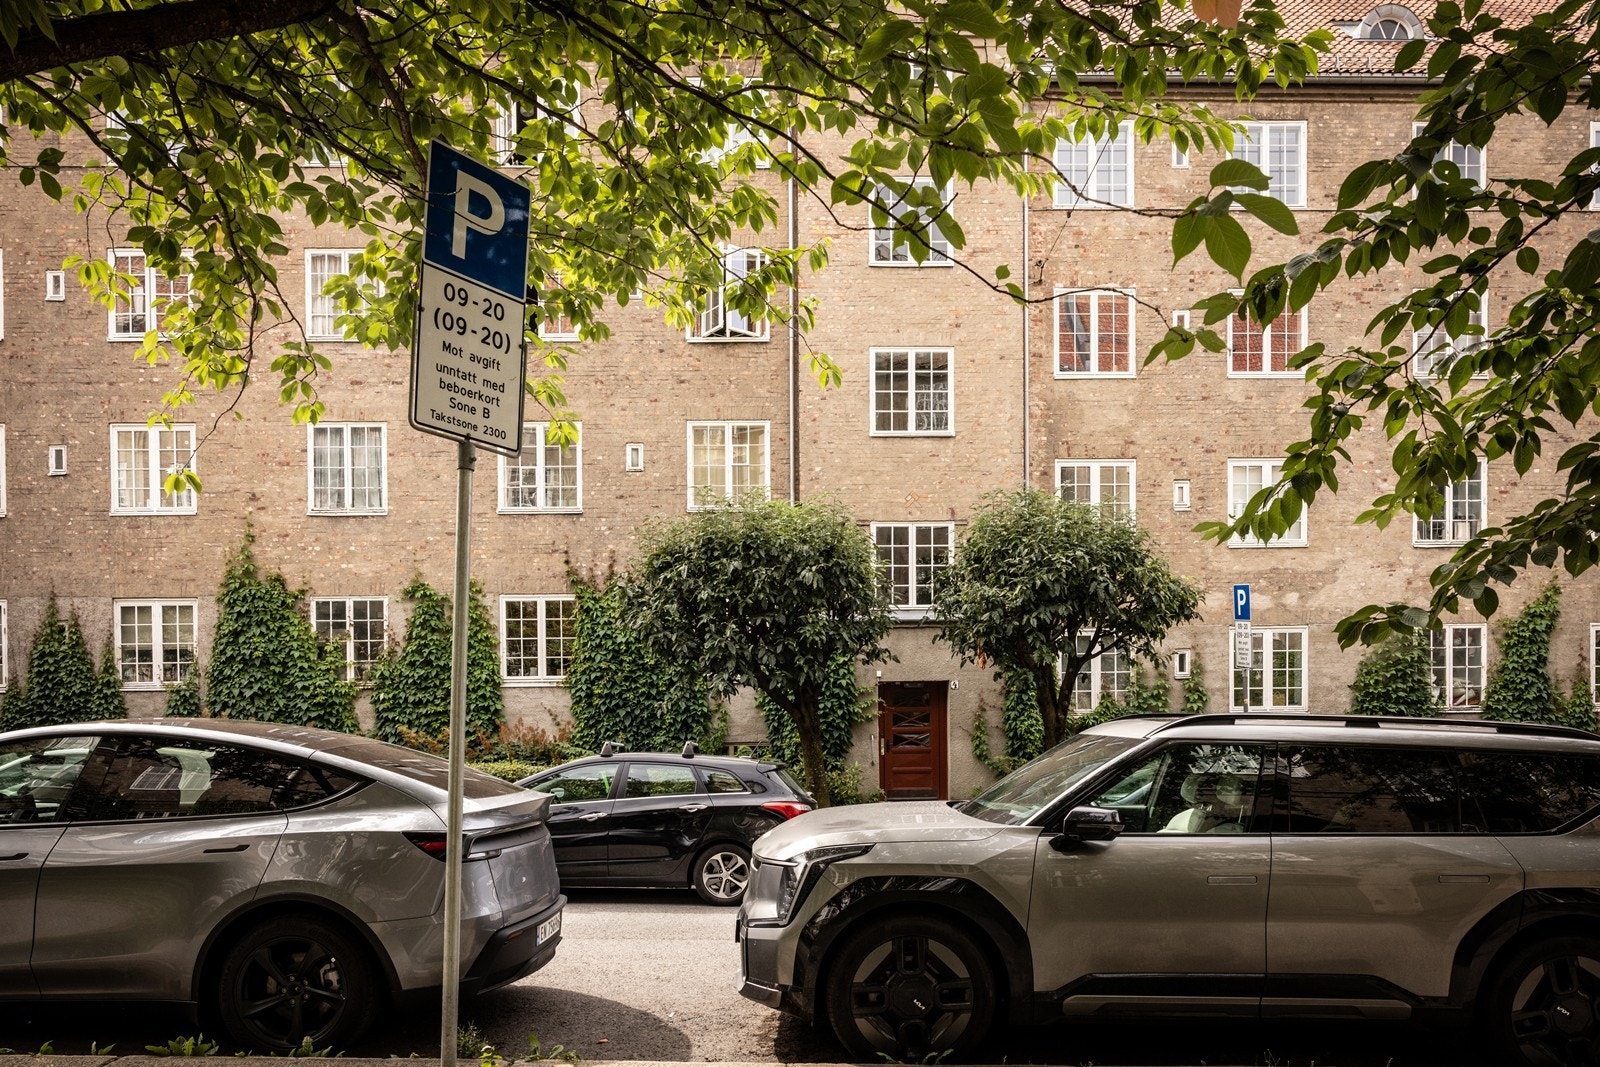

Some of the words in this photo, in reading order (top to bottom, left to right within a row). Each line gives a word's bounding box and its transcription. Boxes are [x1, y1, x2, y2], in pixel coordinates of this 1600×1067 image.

[451, 169, 506, 260] P
[443, 282, 505, 322] 09-20
[433, 307, 511, 354] (09-20)
[442, 340, 464, 358] Mot
[469, 352, 501, 372] avgift
[435, 362, 477, 384] unntatt
[482, 378, 505, 394] med
[439, 377, 501, 408] beboerkort
[430, 408, 479, 432] Takstsone
[482, 425, 507, 440] 2300
[449, 397, 477, 416] Sone
[482, 407, 491, 419] B
[1237, 589, 1246, 615] P
